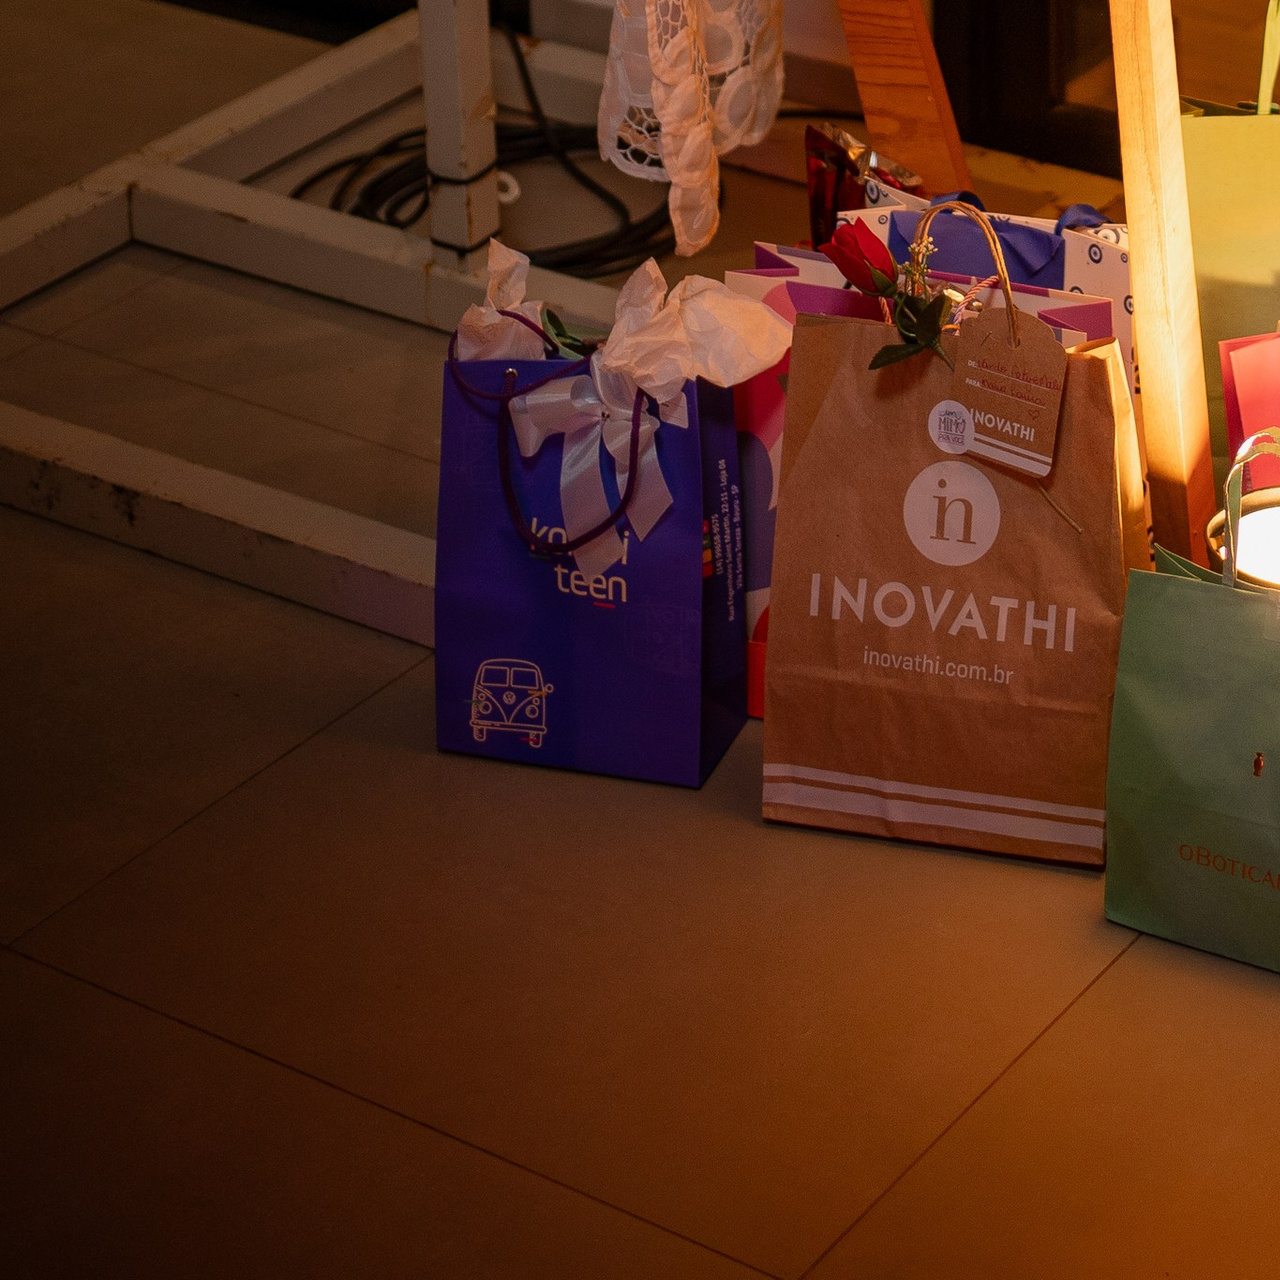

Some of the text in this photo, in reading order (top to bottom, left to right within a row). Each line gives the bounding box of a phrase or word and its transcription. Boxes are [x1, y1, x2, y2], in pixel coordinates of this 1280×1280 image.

[969, 408, 1035, 442] INOVATHI
[930, 478, 976, 545] in
[554, 564, 627, 602] teen
[809, 572, 1076, 652] INOVATHI
[863, 646, 1014, 684] inovathi.com.br
